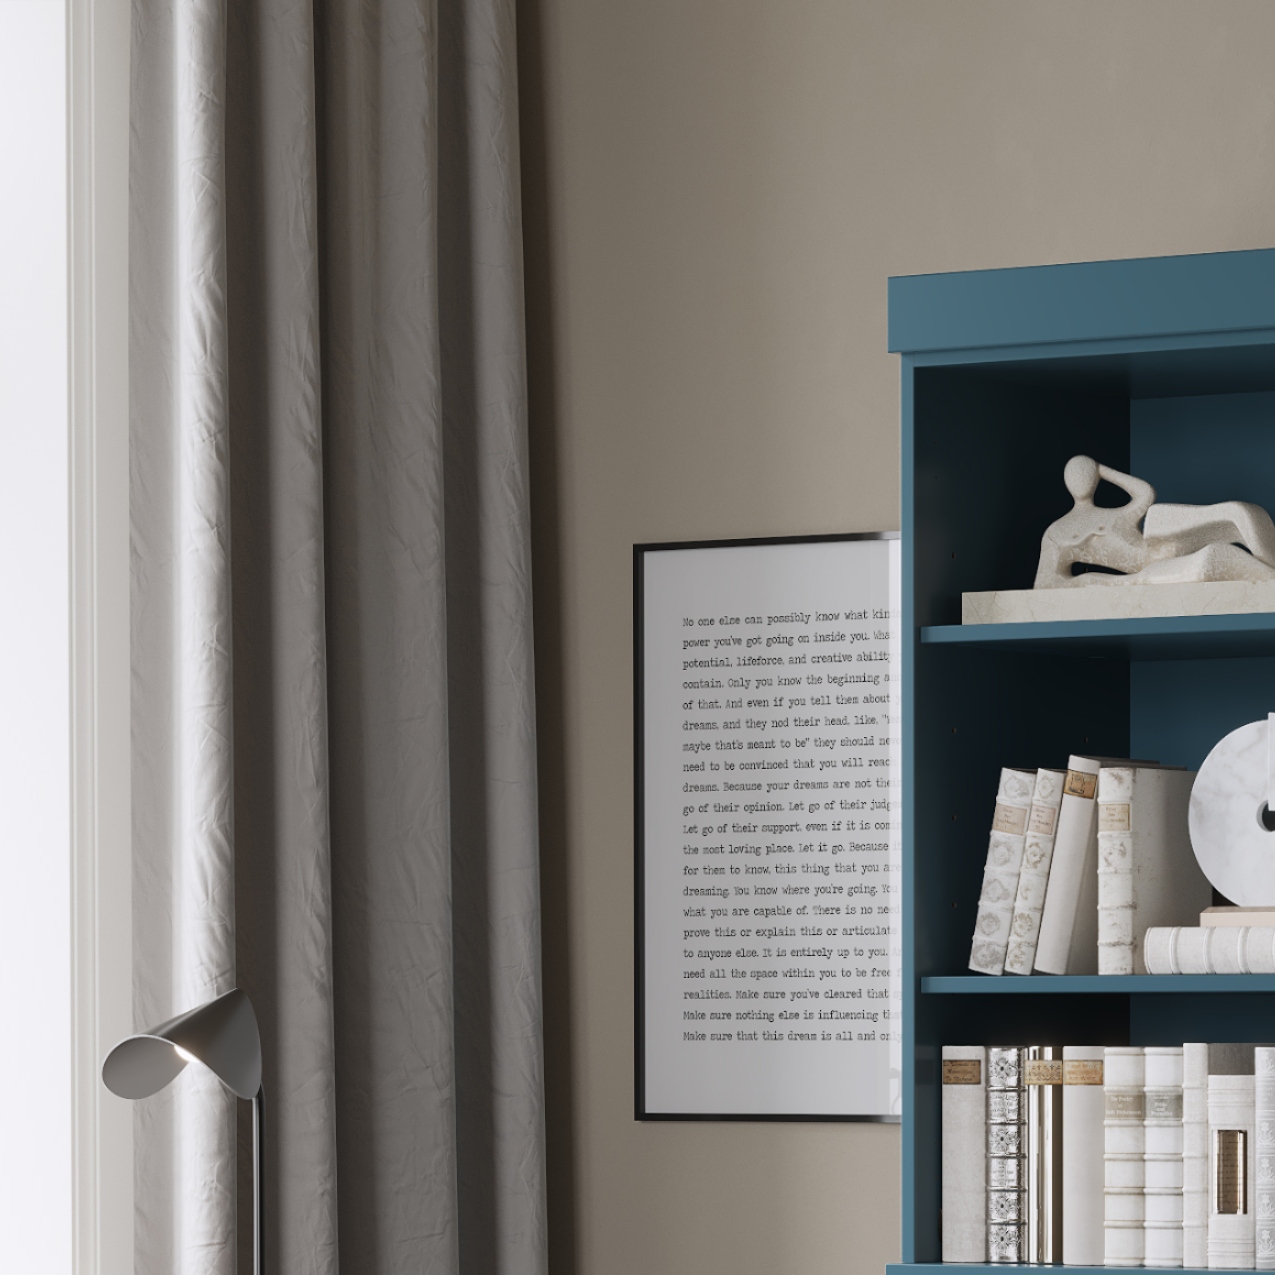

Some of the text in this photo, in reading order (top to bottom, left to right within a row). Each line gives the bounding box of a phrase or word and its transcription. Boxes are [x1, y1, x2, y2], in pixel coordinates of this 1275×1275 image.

[683, 618, 694, 626] No
[698, 618, 715, 626] one
[767, 612, 811, 625] possibly
[815, 611, 840, 622] know
[844, 609, 868, 620] what
[682, 639, 710, 649] power
[746, 635, 762, 648] got
[766, 634, 794, 647] going
[798, 635, 809, 643] on
[814, 631, 846, 643] inside
[788, 654, 807, 665] and
[811, 652, 852, 664] creative
[682, 672, 880, 690] contain. Only you know the beginning
[682, 700, 694, 710] of
[725, 698, 742, 709] And
[747, 699, 769, 708] even
[773, 697, 784, 707] if
[788, 698, 806, 709] you
[810, 695, 831, 705] tell
[836, 694, 859, 704] them
[863, 694, 892, 703] about
[723, 717, 820, 731] and they nod their
[780, 739, 791, 748] to
[814, 737, 836, 750] they
[840, 736, 874, 746] should
[683, 758, 863, 772] need to be convinced that you will
[723, 782, 762, 791] Because
[767, 782, 790, 793] your
[793, 780, 829, 789] dreams
[833, 781, 850, 789] are
[855, 778, 872, 788] not
[682, 806, 695, 817] go
[698, 803, 709, 813] of
[713, 803, 740, 812] their
[789, 801, 804, 811] Let
[809, 803, 820, 813] go
[824, 800, 836, 810] of
[839, 799, 867, 810] their
[683, 820, 871, 836] Let go of their even if it is
[683, 845, 699, 855] the
[728, 844, 761, 856] loving
[799, 843, 814, 852] Let
[818, 842, 828, 852] it
[832, 844, 845, 855] go.
[849, 842, 889, 852] Because
[683, 862, 879, 876] for to this thing that you
[734, 886, 749, 896] You
[754, 885, 778, 895] know
[782, 884, 810, 895] where
[847, 883, 878, 897] going.
[683, 905, 873, 919] what you are capable of. There is no
[683, 929, 710, 940] prove
[714, 927, 737, 937] this
[740, 929, 752, 937] or
[756, 926, 796, 939] explain
[800, 926, 823, 936] this
[826, 928, 838, 936] or
[683, 949, 694, 958] to
[698, 950, 732, 961] anyone
[735, 948, 759, 957] else.
[762, 948, 772, 957] It
[776, 947, 786, 957] is
[790, 947, 833, 960] entirely
[837, 949, 850, 959] up
[854, 947, 864, 956] to
[683, 1009, 879, 1023] Make sure nothing else is influencing
[683, 1030, 875, 1041] Make sure that this dream is all and
